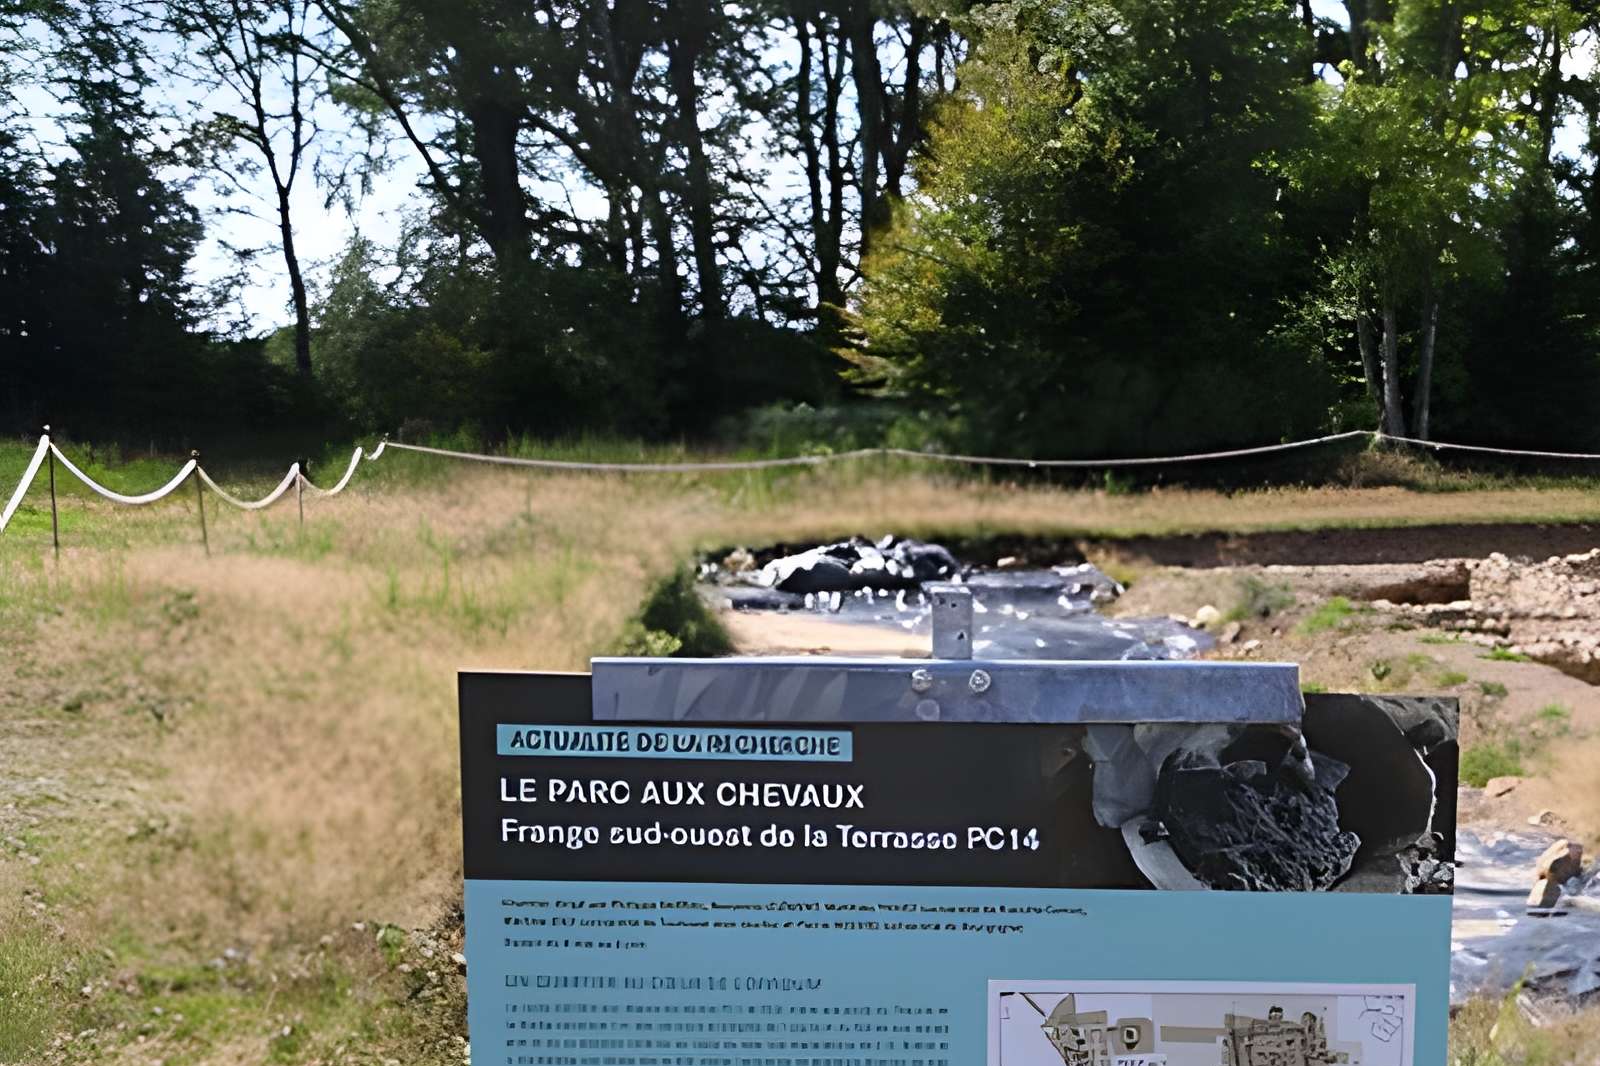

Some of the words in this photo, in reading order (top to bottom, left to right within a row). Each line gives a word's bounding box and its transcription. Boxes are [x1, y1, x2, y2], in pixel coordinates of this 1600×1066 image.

[500, 777, 537, 802] LE
[549, 778, 631, 805] PARC
[640, 780, 705, 805] AUX
[716, 781, 865, 809] CHEVAUX
[804, 824, 828, 848] la
